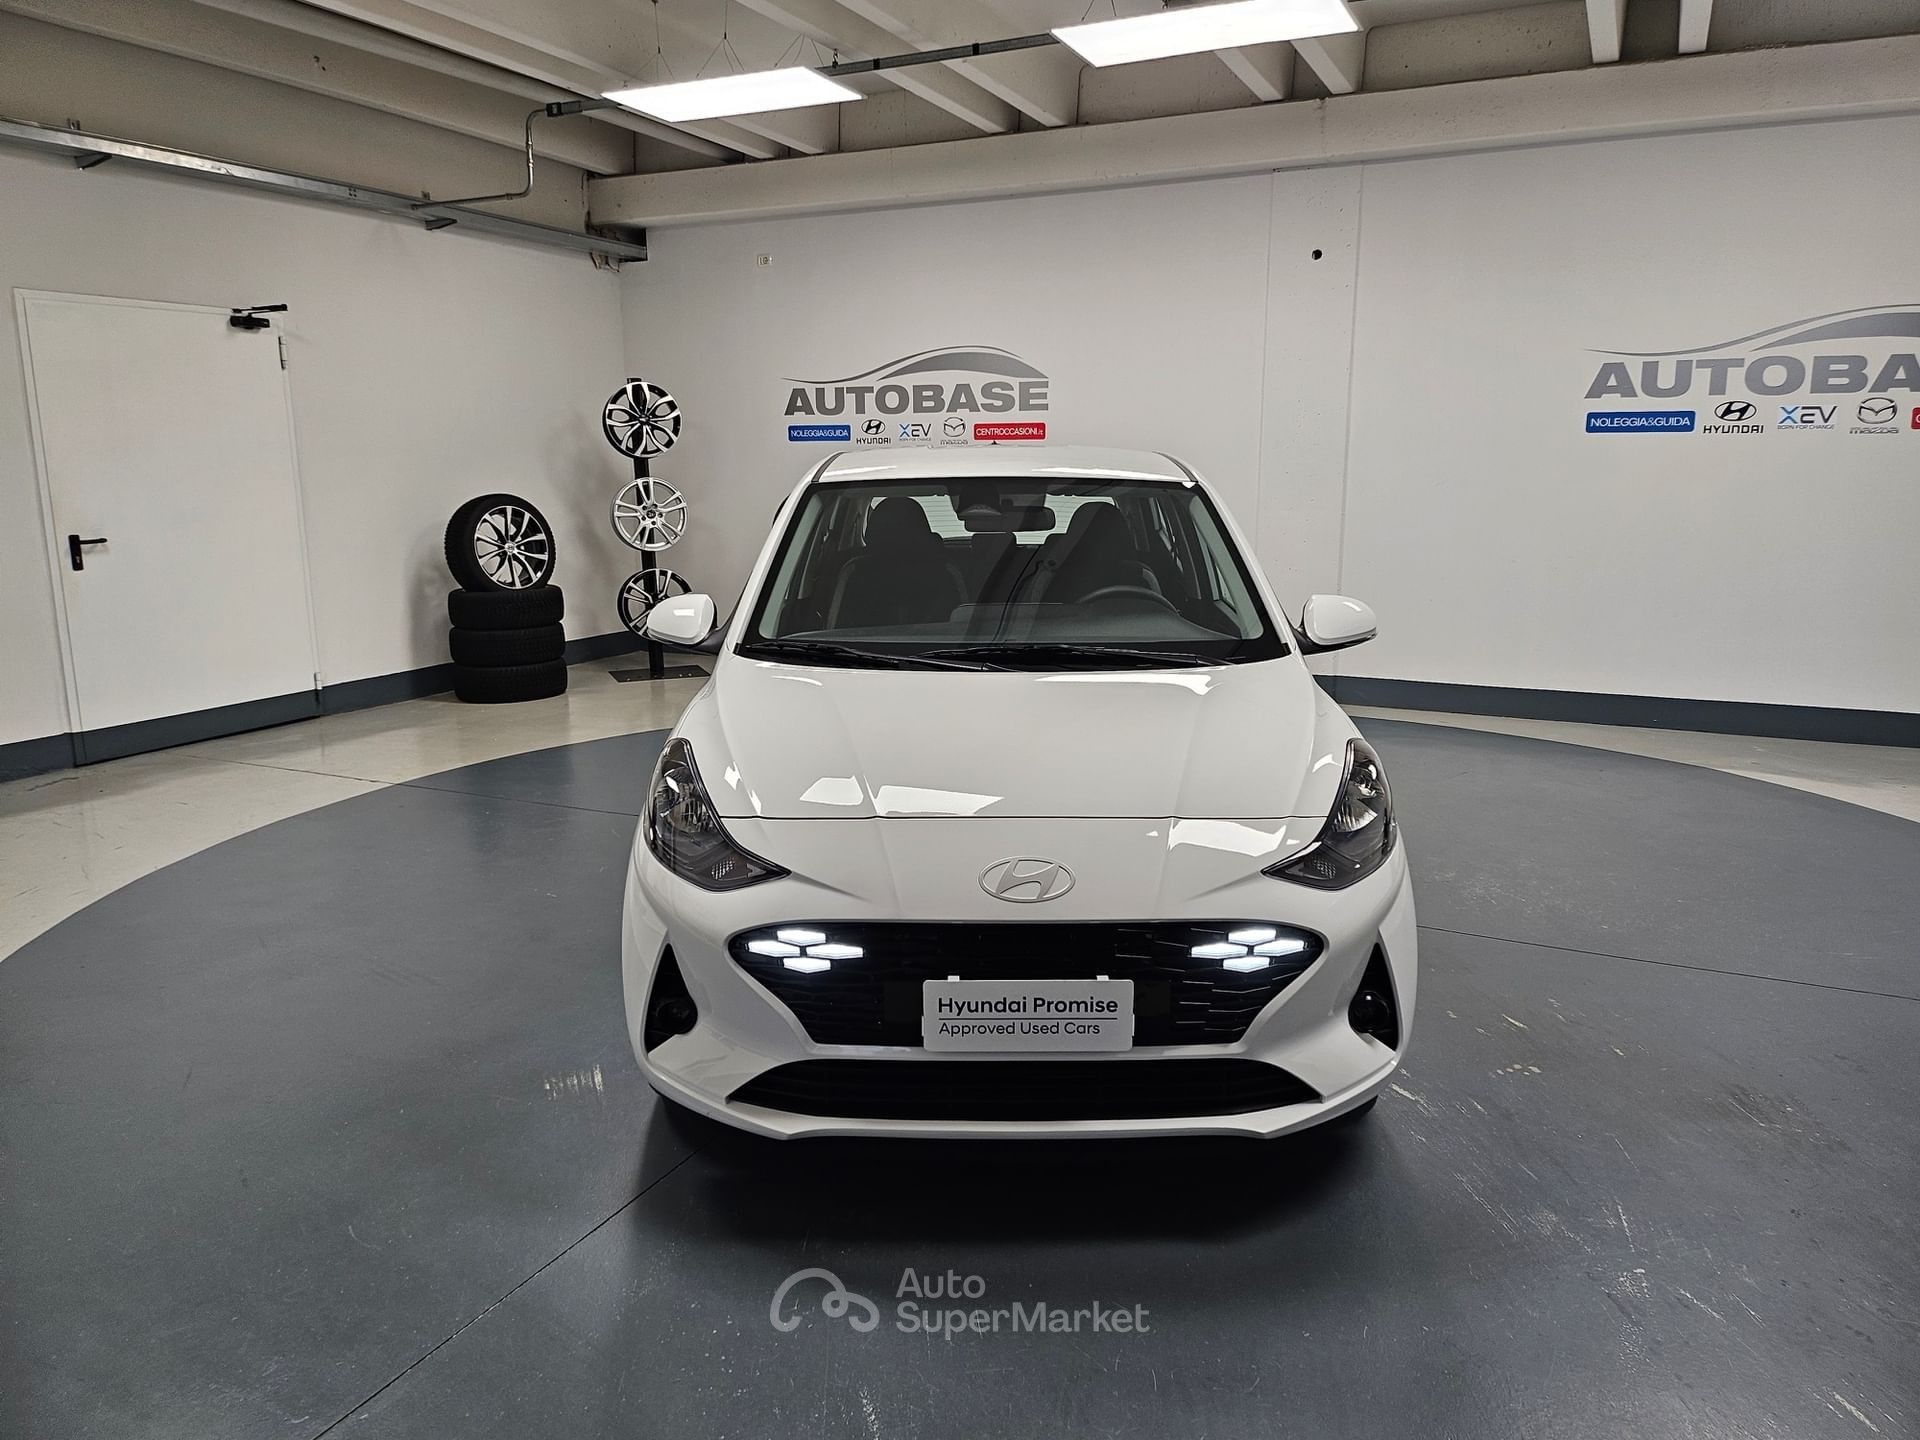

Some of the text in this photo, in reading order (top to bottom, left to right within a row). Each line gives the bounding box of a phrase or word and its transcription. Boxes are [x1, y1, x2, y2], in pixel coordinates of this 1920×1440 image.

[784, 381, 1049, 416] AUTOBASE
[1778, 406, 1838, 424] XEV
[1590, 416, 1691, 427] NOLEGGIA&GUIDA
[790, 429, 849, 438] NOLEGGIA&GUIDA
[899, 423, 931, 437] XEV
[975, 427, 1044, 437] CENTROCCASIONI.it
[1703, 424, 1764, 434] HYUNDAI
[856, 437, 891, 445] HYUNDAI
[938, 996, 1118, 1016] Hyundai Promise
[939, 1021, 1100, 1037] Approved Used Cars
